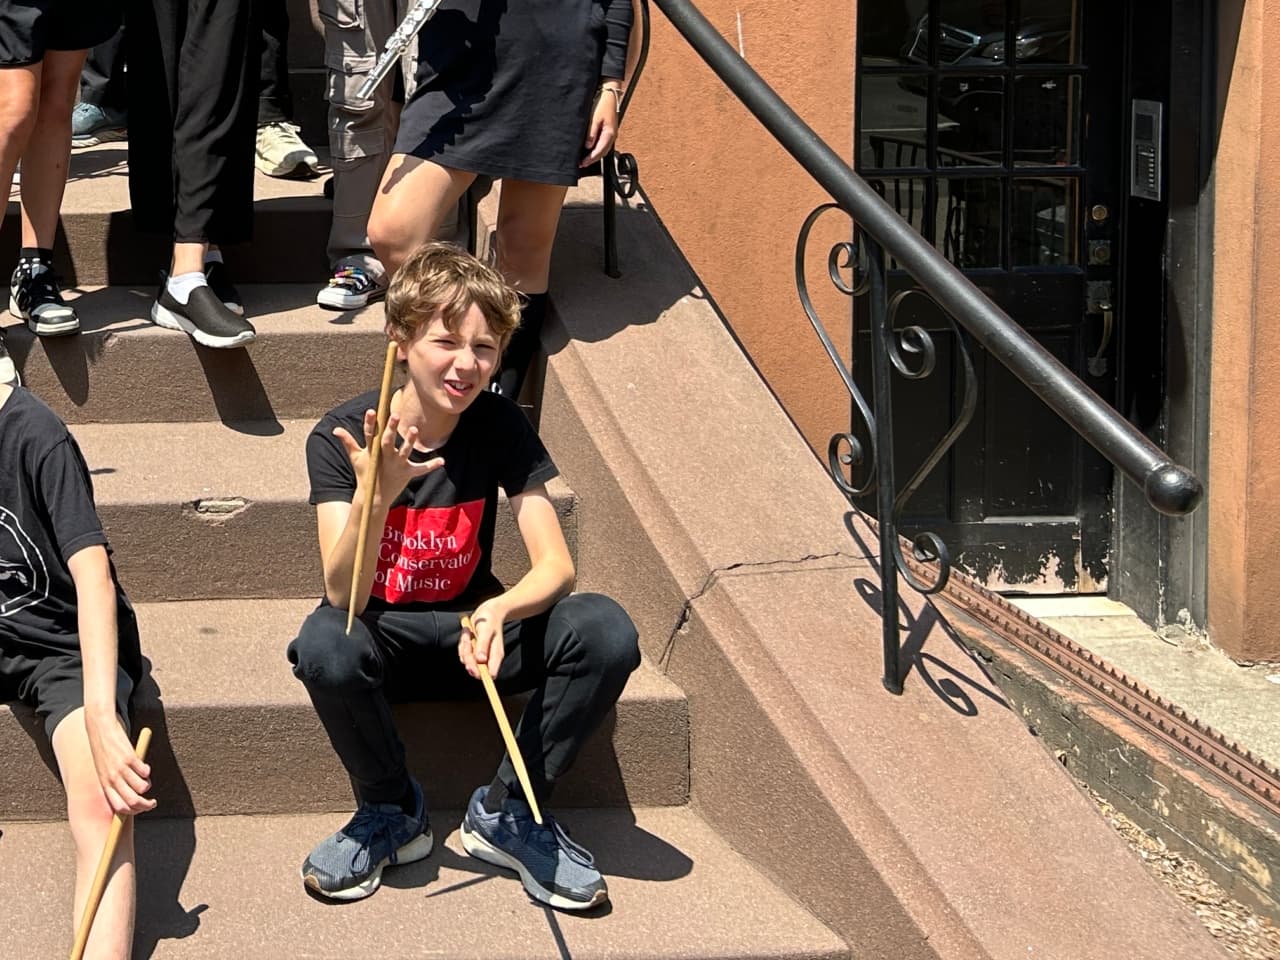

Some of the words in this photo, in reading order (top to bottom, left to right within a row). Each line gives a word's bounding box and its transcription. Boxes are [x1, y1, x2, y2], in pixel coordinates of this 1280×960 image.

[383, 525, 457, 555] Brooklyn
[378, 542, 473, 571] Conservato
[374, 568, 394, 586] of
[395, 572, 451, 592] Music
